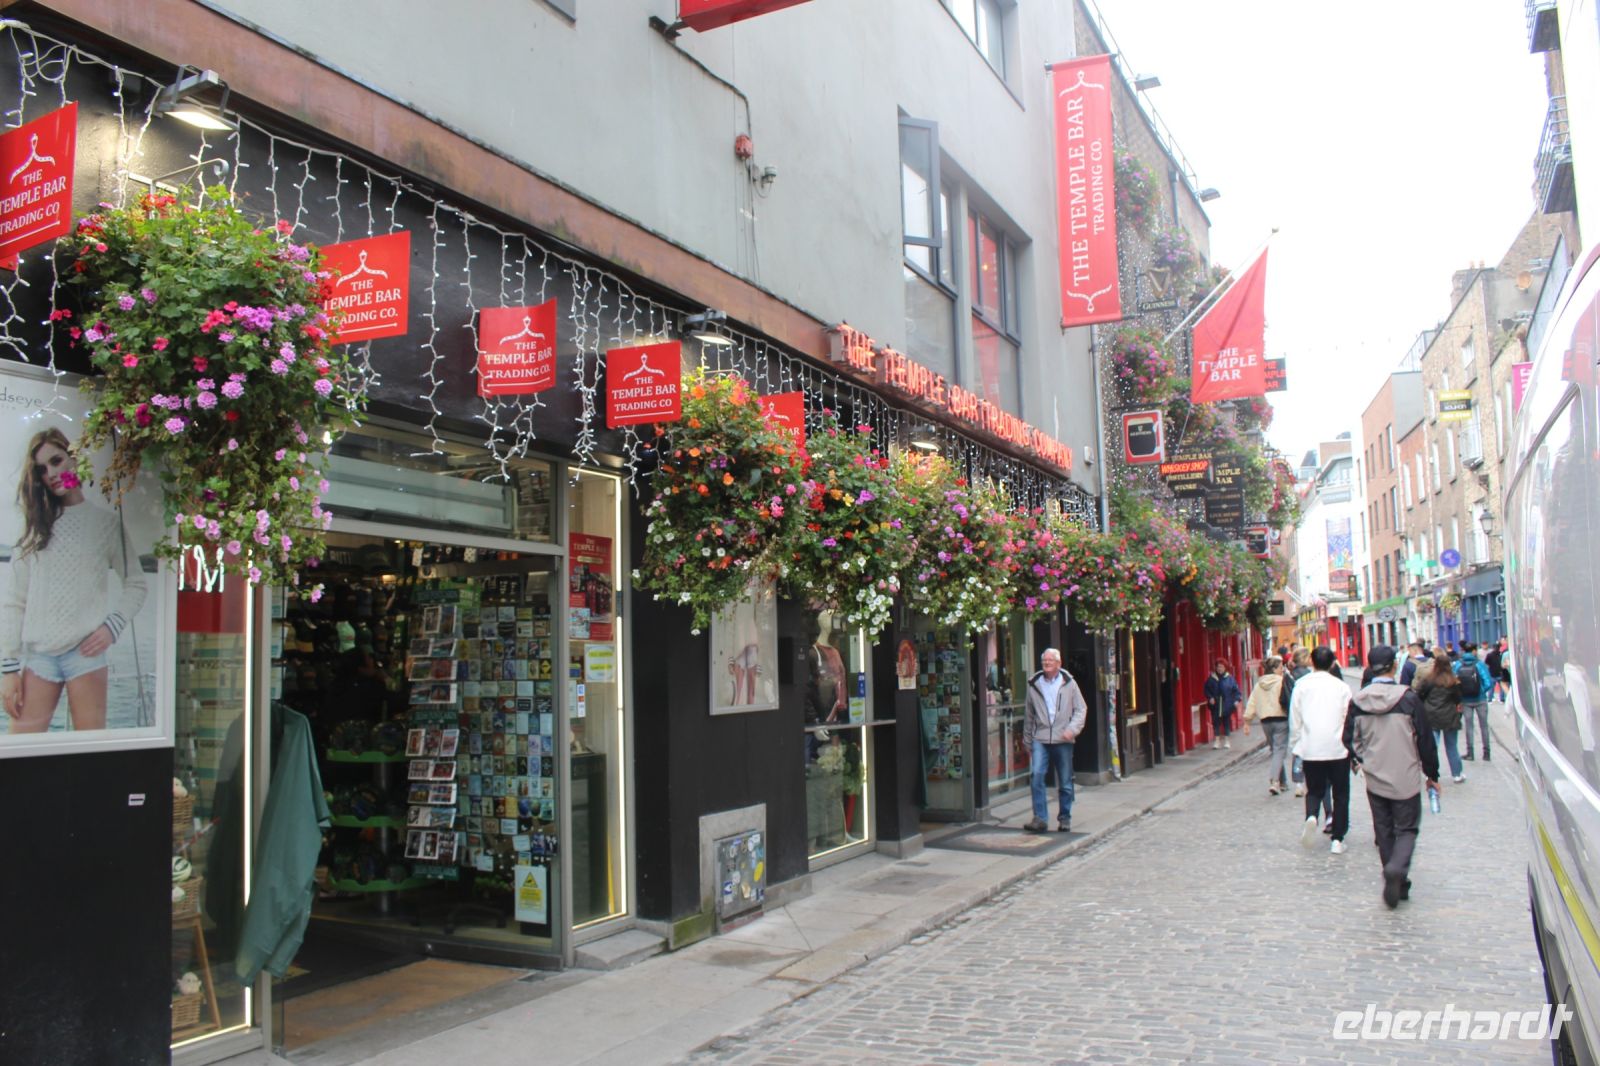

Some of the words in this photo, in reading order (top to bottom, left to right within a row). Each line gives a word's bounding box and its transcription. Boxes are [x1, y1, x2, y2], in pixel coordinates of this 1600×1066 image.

[1067, 96, 1084, 140] BAR
[22, 169, 43, 186] THE
[43, 176, 66, 198] BAR
[1069, 145, 1088, 235] TEMPLE
[1092, 164, 1105, 235] TRADING
[0, 208, 44, 235] TRADING
[1073, 239, 1090, 287] THE
[350, 279, 374, 291] THE
[375, 288, 401, 303] BAR
[379, 307, 398, 319] CO.
[515, 341, 537, 351] THE
[484, 352, 536, 365] TEMPLE
[537, 346, 552, 361] BAR
[487, 368, 539, 379] TRADING
[836, 323, 877, 372] THE
[881, 348, 946, 405] TEMPLE
[948, 383, 979, 421] BAR
[1211, 369, 1242, 382] BAR
[635, 376, 654, 386] THE
[612, 386, 653, 400] TEMPLE
[655, 384, 676, 396] BAR
[614, 400, 657, 412] TRADING
[659, 399, 672, 408] CO
